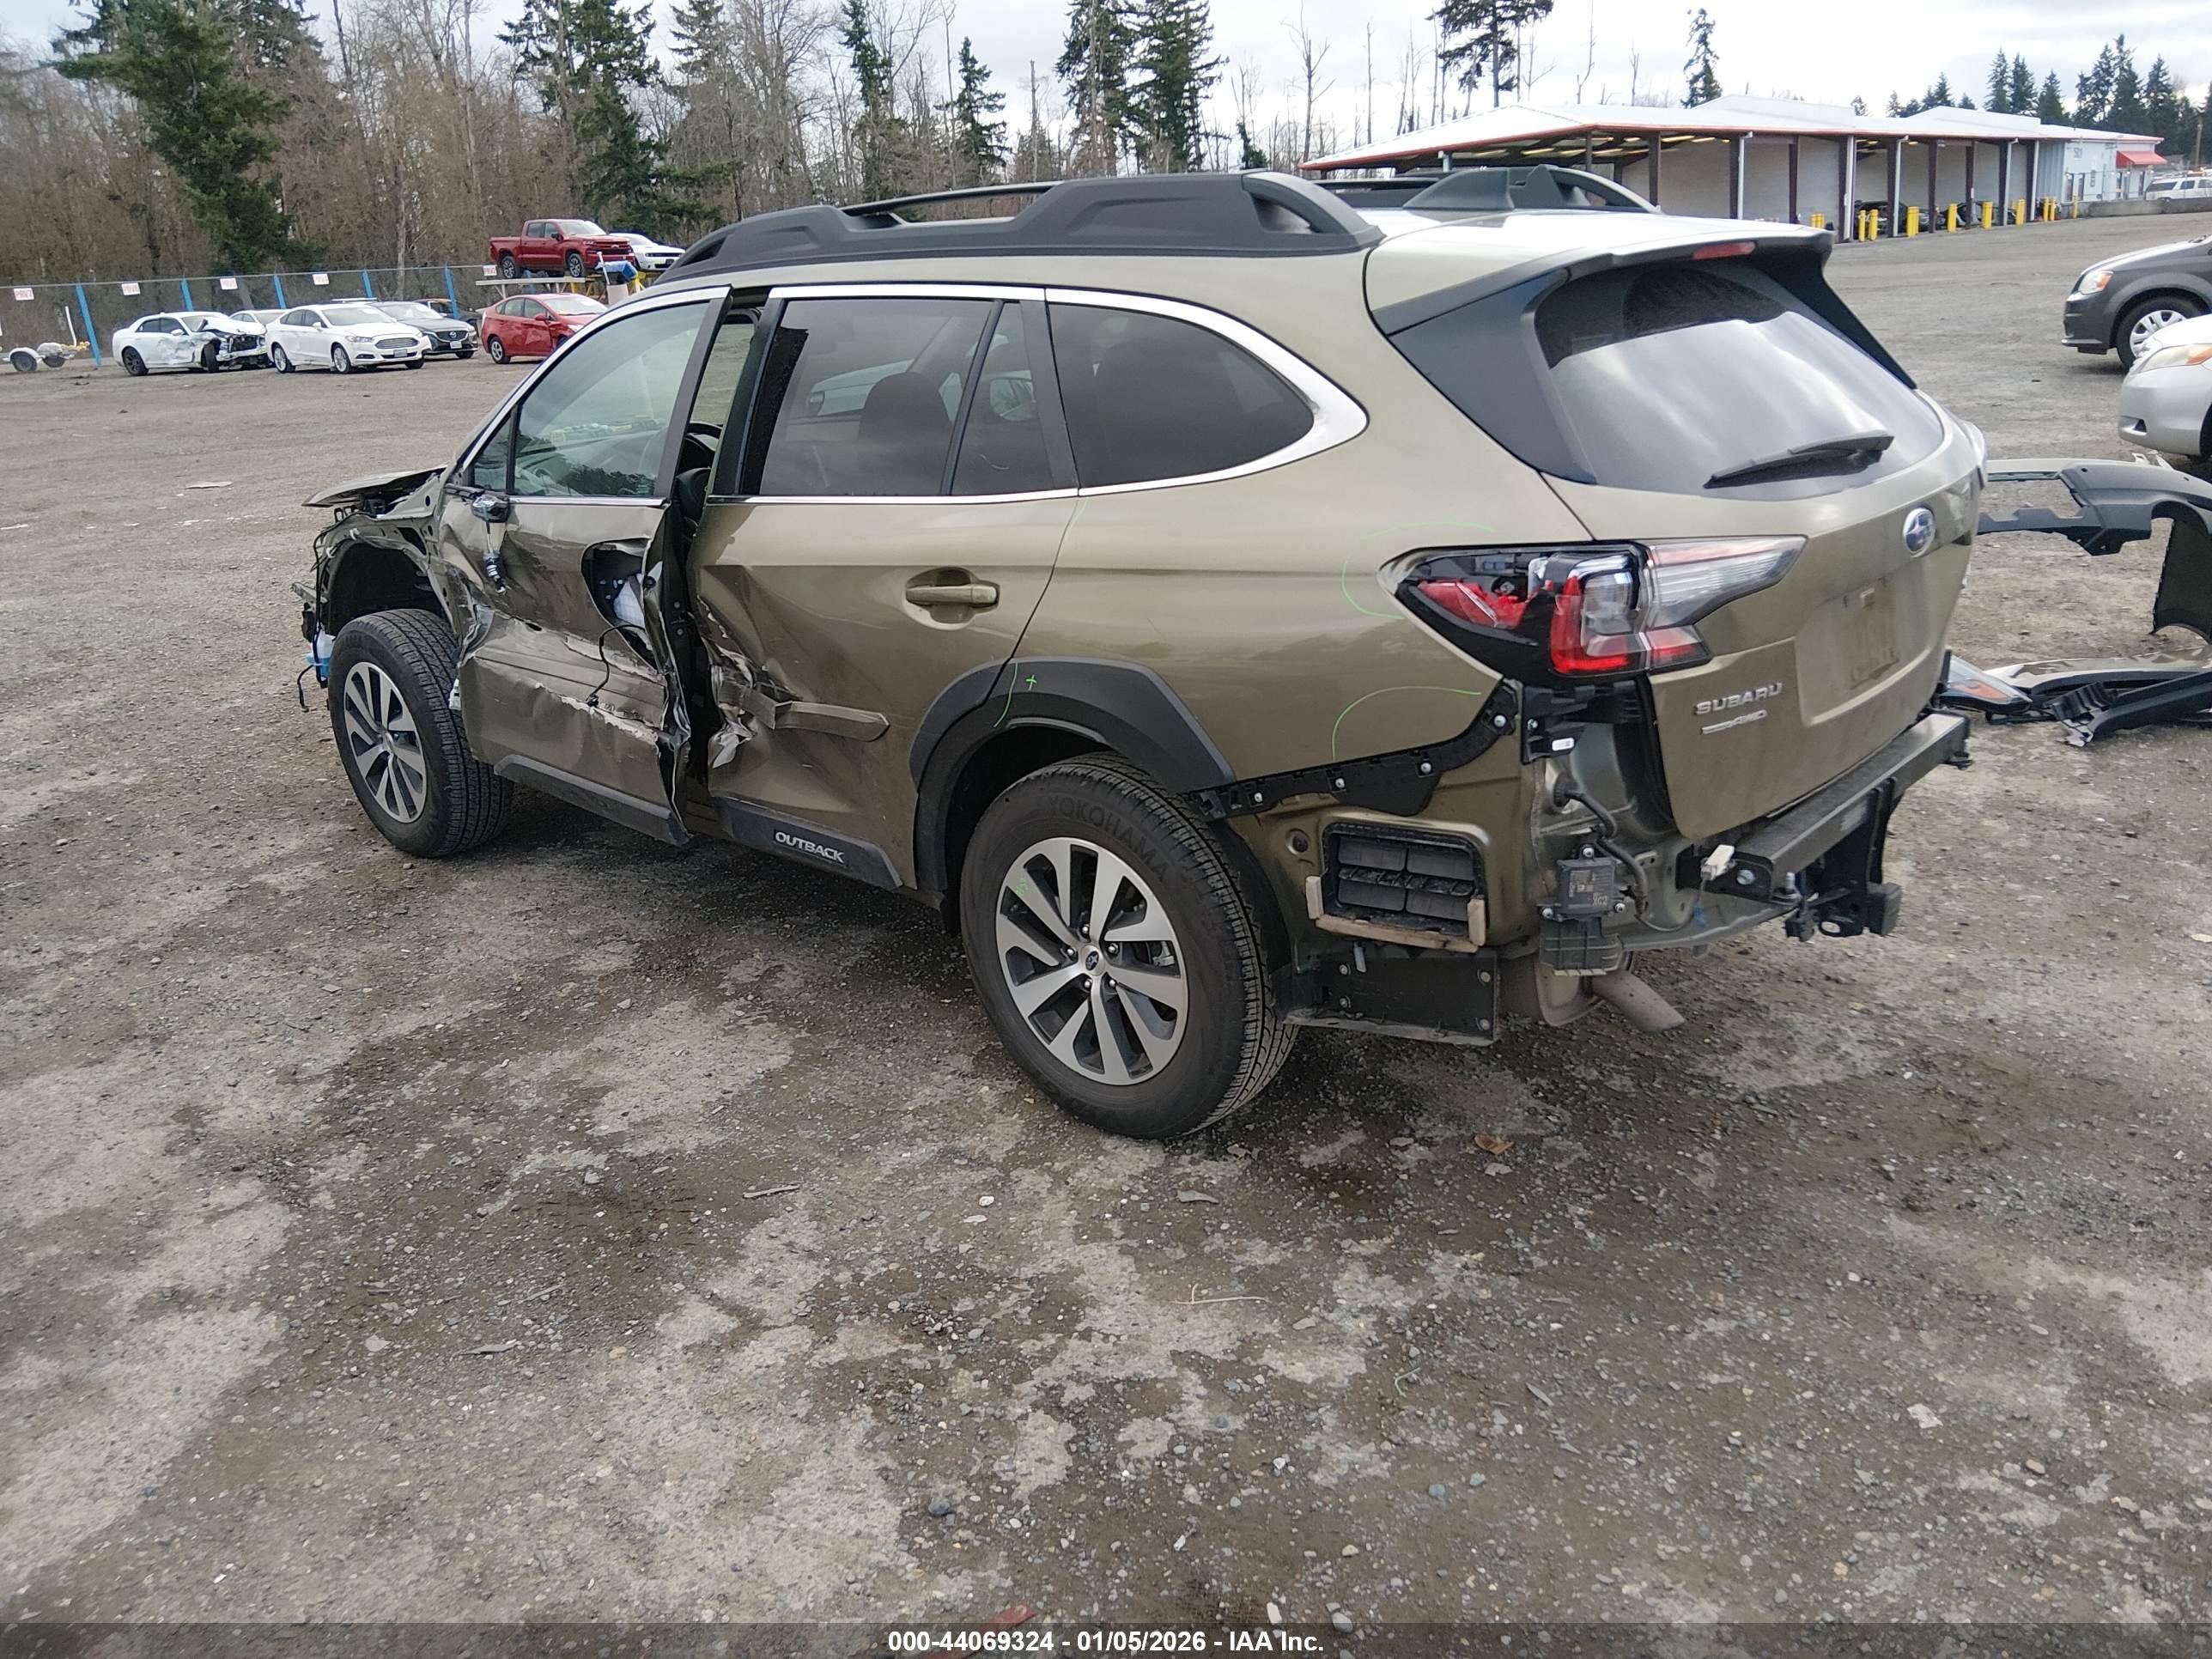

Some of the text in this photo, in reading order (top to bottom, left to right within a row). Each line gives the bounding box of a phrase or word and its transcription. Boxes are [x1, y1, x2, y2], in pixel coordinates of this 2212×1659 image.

[1695, 682, 1783, 715] SUBARU
[775, 831, 846, 864] OUTBACK
[1048, 795, 1170, 882] YOKOHAMA
